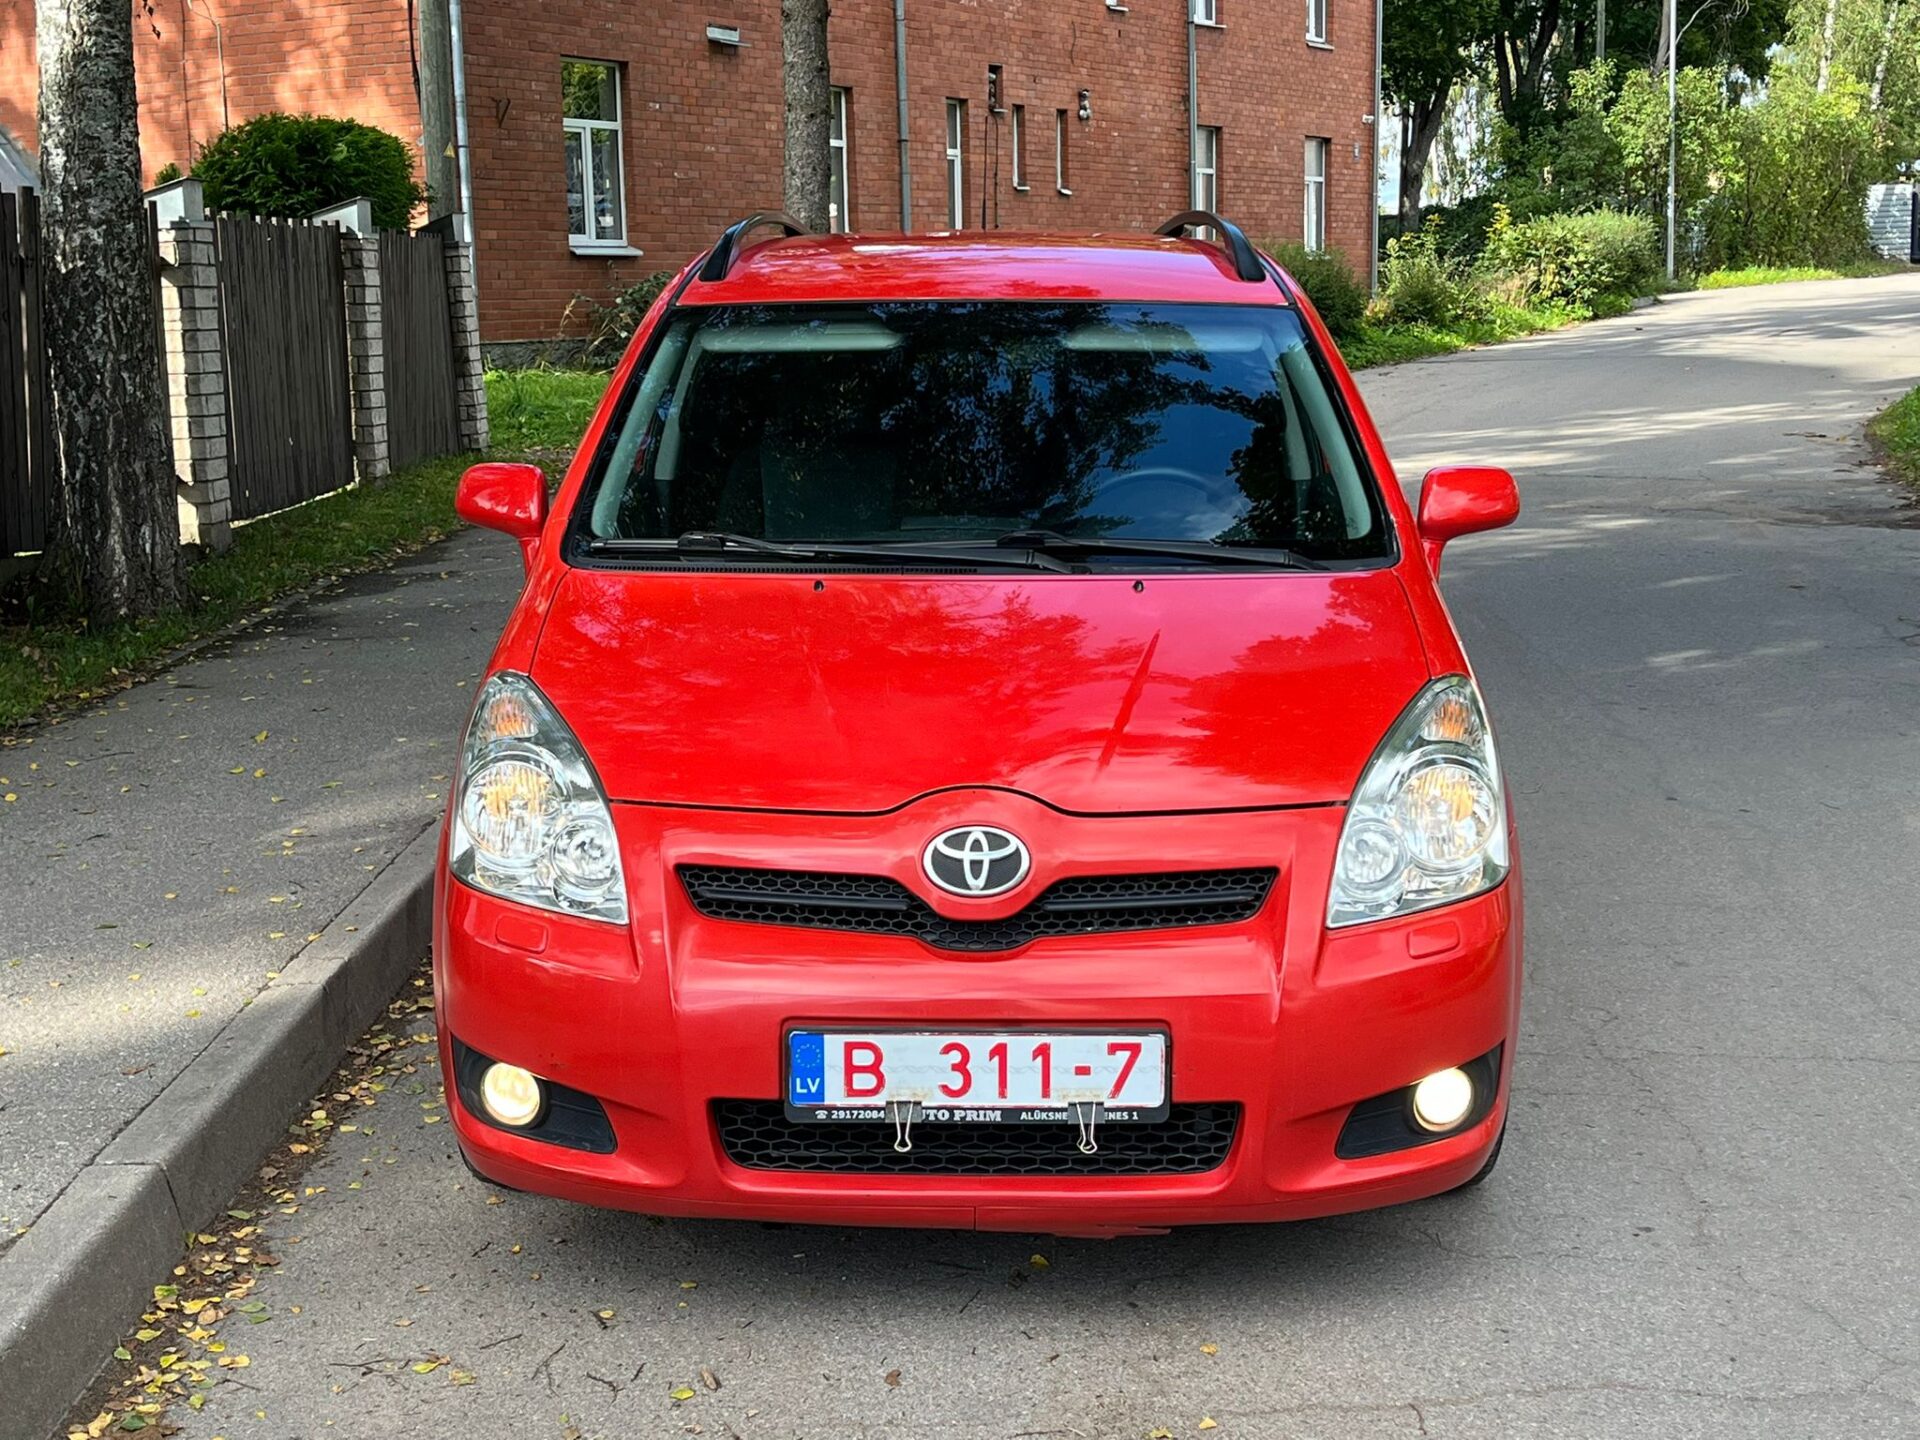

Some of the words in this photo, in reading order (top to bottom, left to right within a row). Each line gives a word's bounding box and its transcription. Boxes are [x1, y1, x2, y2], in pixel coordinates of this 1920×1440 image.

[843, 1041, 886, 1099] B
[938, 1042, 1143, 1100] 311-7
[796, 1077, 820, 1094] LV
[921, 1109, 950, 1121] TO
[953, 1109, 1002, 1121] PRIM
[1132, 1111, 1139, 1120] 1
